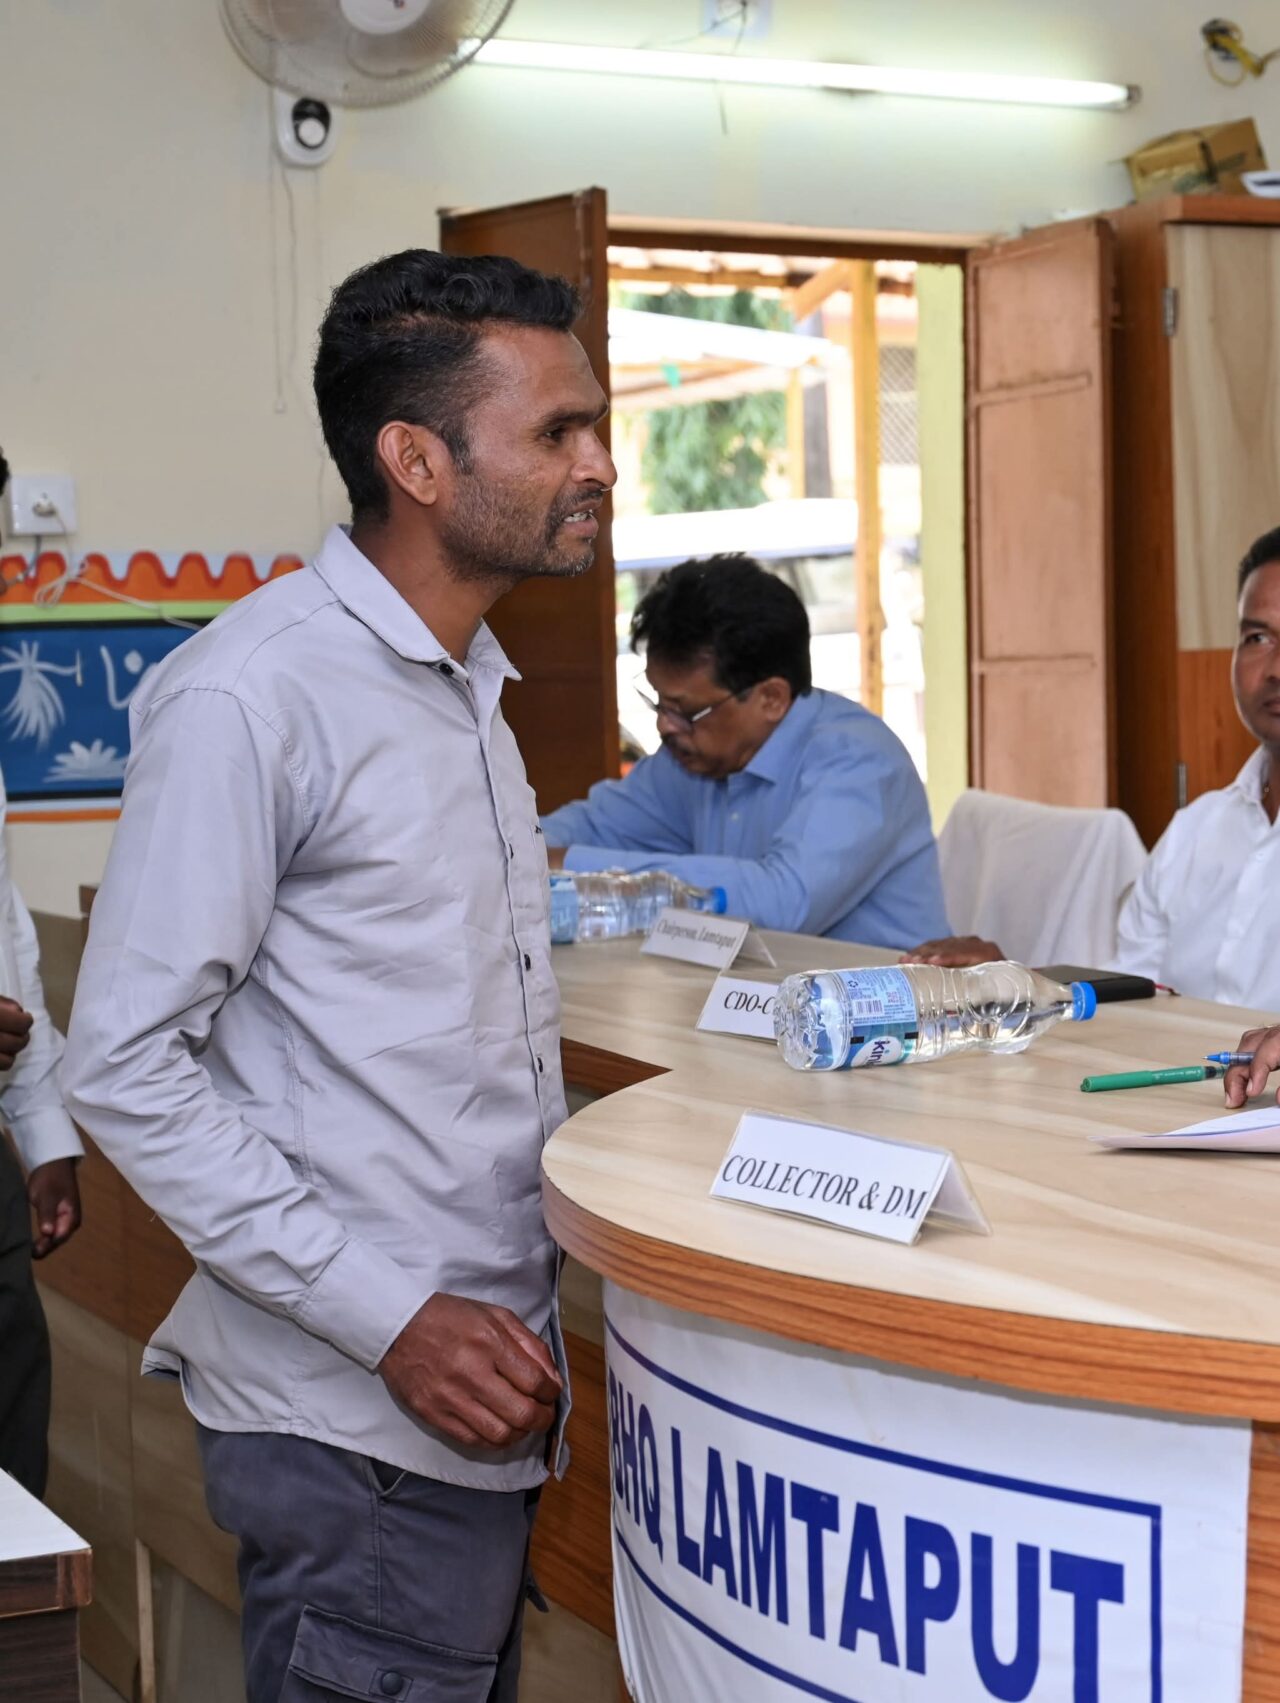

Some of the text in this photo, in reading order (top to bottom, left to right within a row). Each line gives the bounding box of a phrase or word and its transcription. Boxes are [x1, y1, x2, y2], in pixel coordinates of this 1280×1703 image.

[721, 1154, 928, 1219] COLLECTOR & DM
[670, 1425, 1125, 1703] LAMTAPUT
